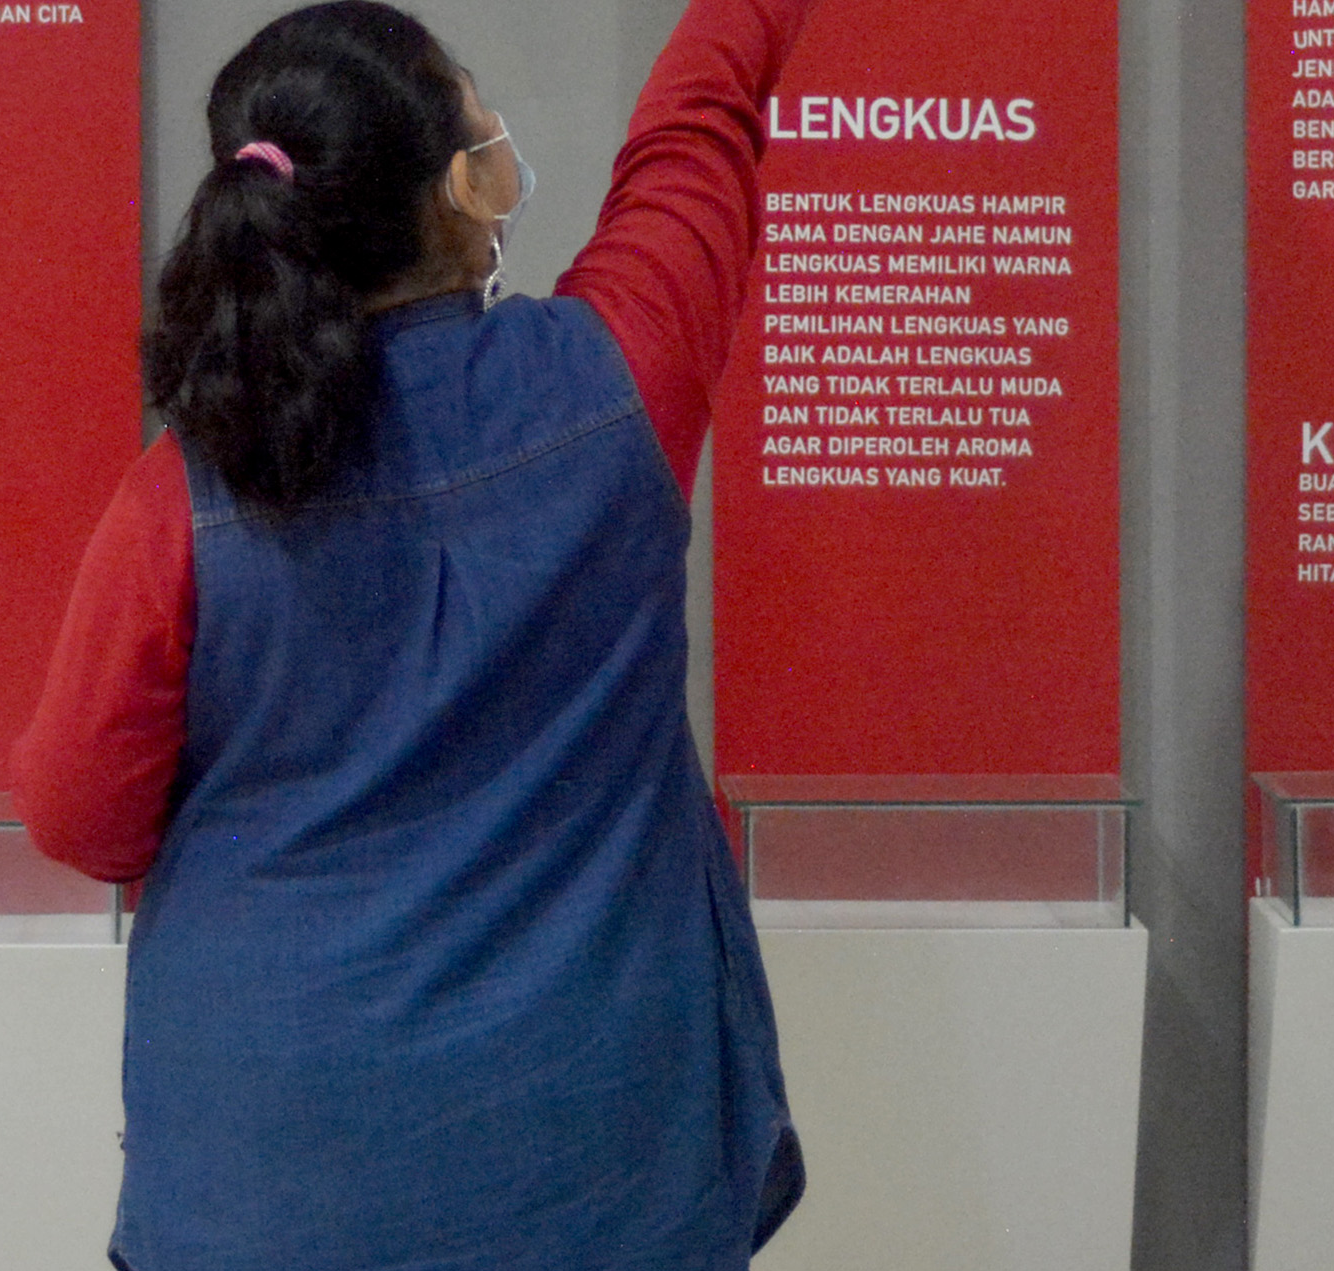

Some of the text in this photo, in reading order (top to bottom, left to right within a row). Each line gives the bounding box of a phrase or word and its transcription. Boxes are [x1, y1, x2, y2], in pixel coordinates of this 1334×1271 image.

[768, 95, 1037, 142] LENGKUAS
[765, 192, 1066, 215] BENTUK LENGKUAS HAMPIR
[765, 223, 1072, 245] SAMA DENGAN JAHE NAMUN
[765, 253, 1073, 276] LENGKUAS MEMILIKI WARNA
[763, 375, 1063, 397] YANG TIDAK TERLALU MUDA
